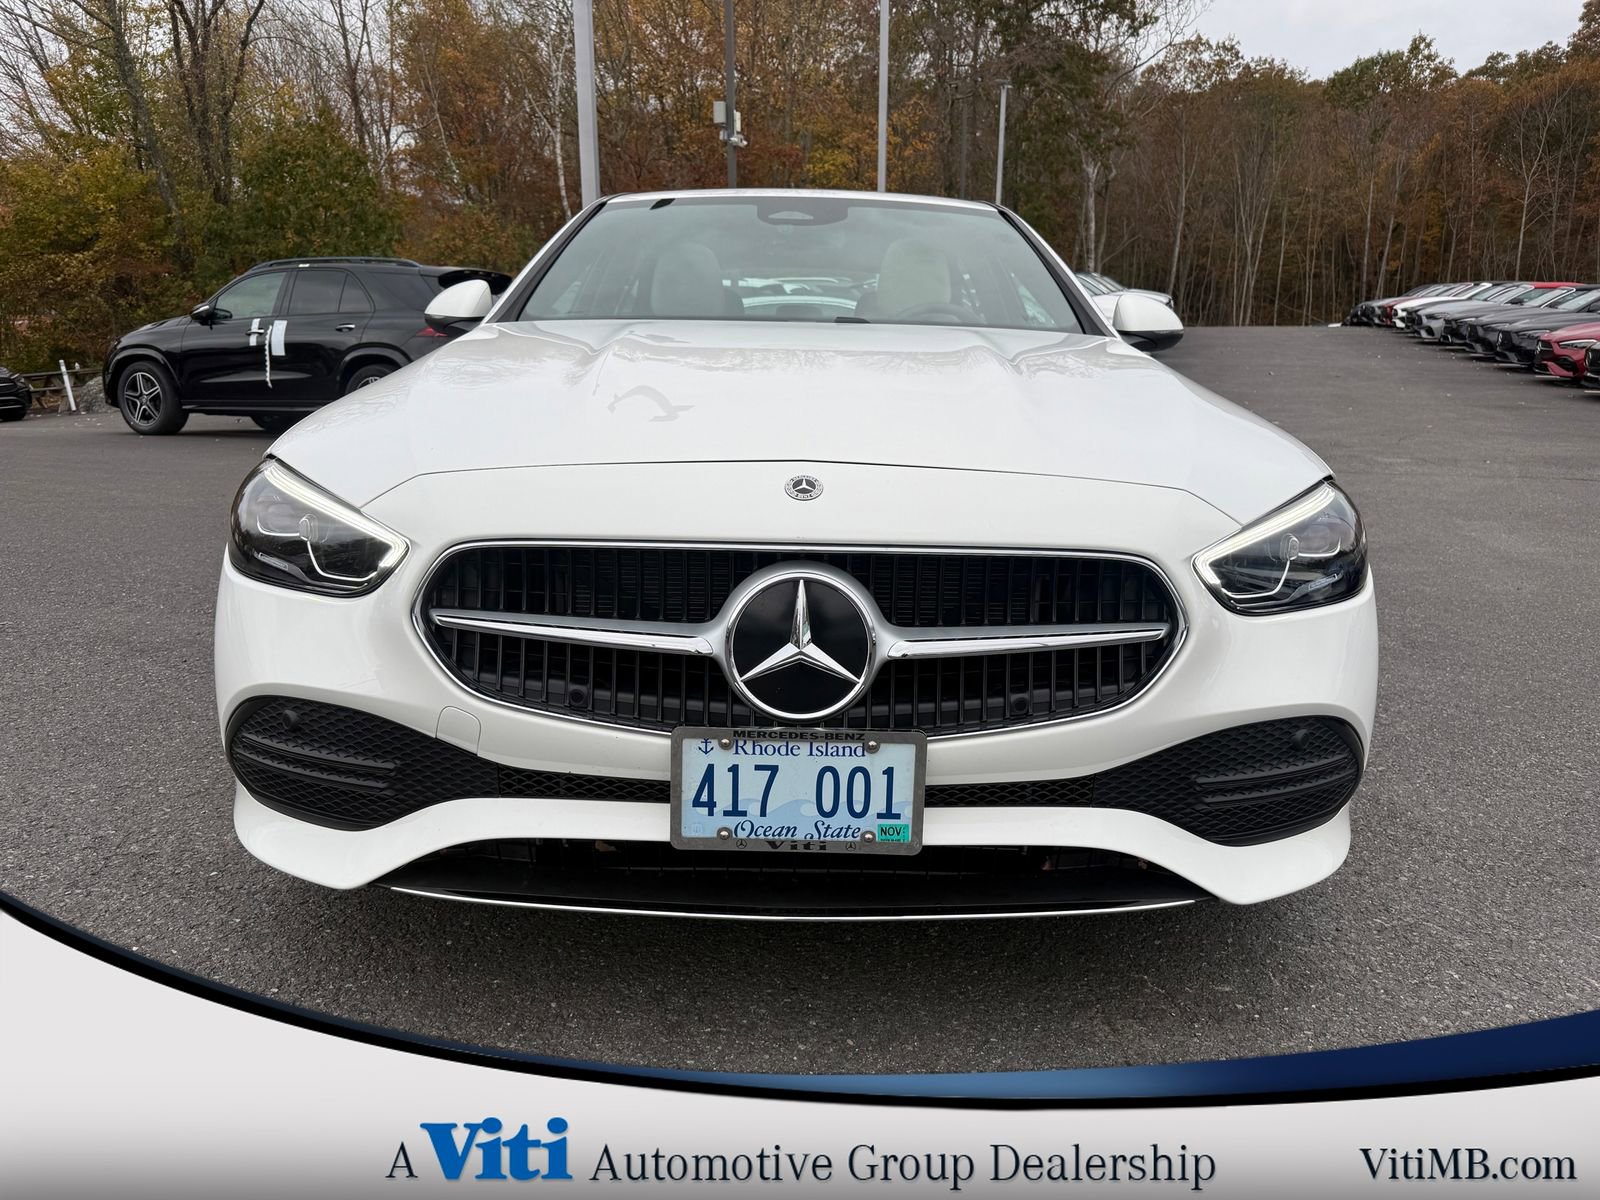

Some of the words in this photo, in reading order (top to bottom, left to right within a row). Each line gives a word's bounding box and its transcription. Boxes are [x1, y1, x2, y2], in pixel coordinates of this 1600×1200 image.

[733, 730, 866, 741] MERCEDES-BENZ
[732, 740, 801, 756] Rhode
[807, 741, 866, 758] Island
[692, 763, 780, 818] 417
[815, 765, 902, 820] 001
[734, 819, 798, 839] Ocean
[804, 820, 861, 840] State
[880, 826, 902, 837] NOV
[765, 841, 827, 851] Viti
